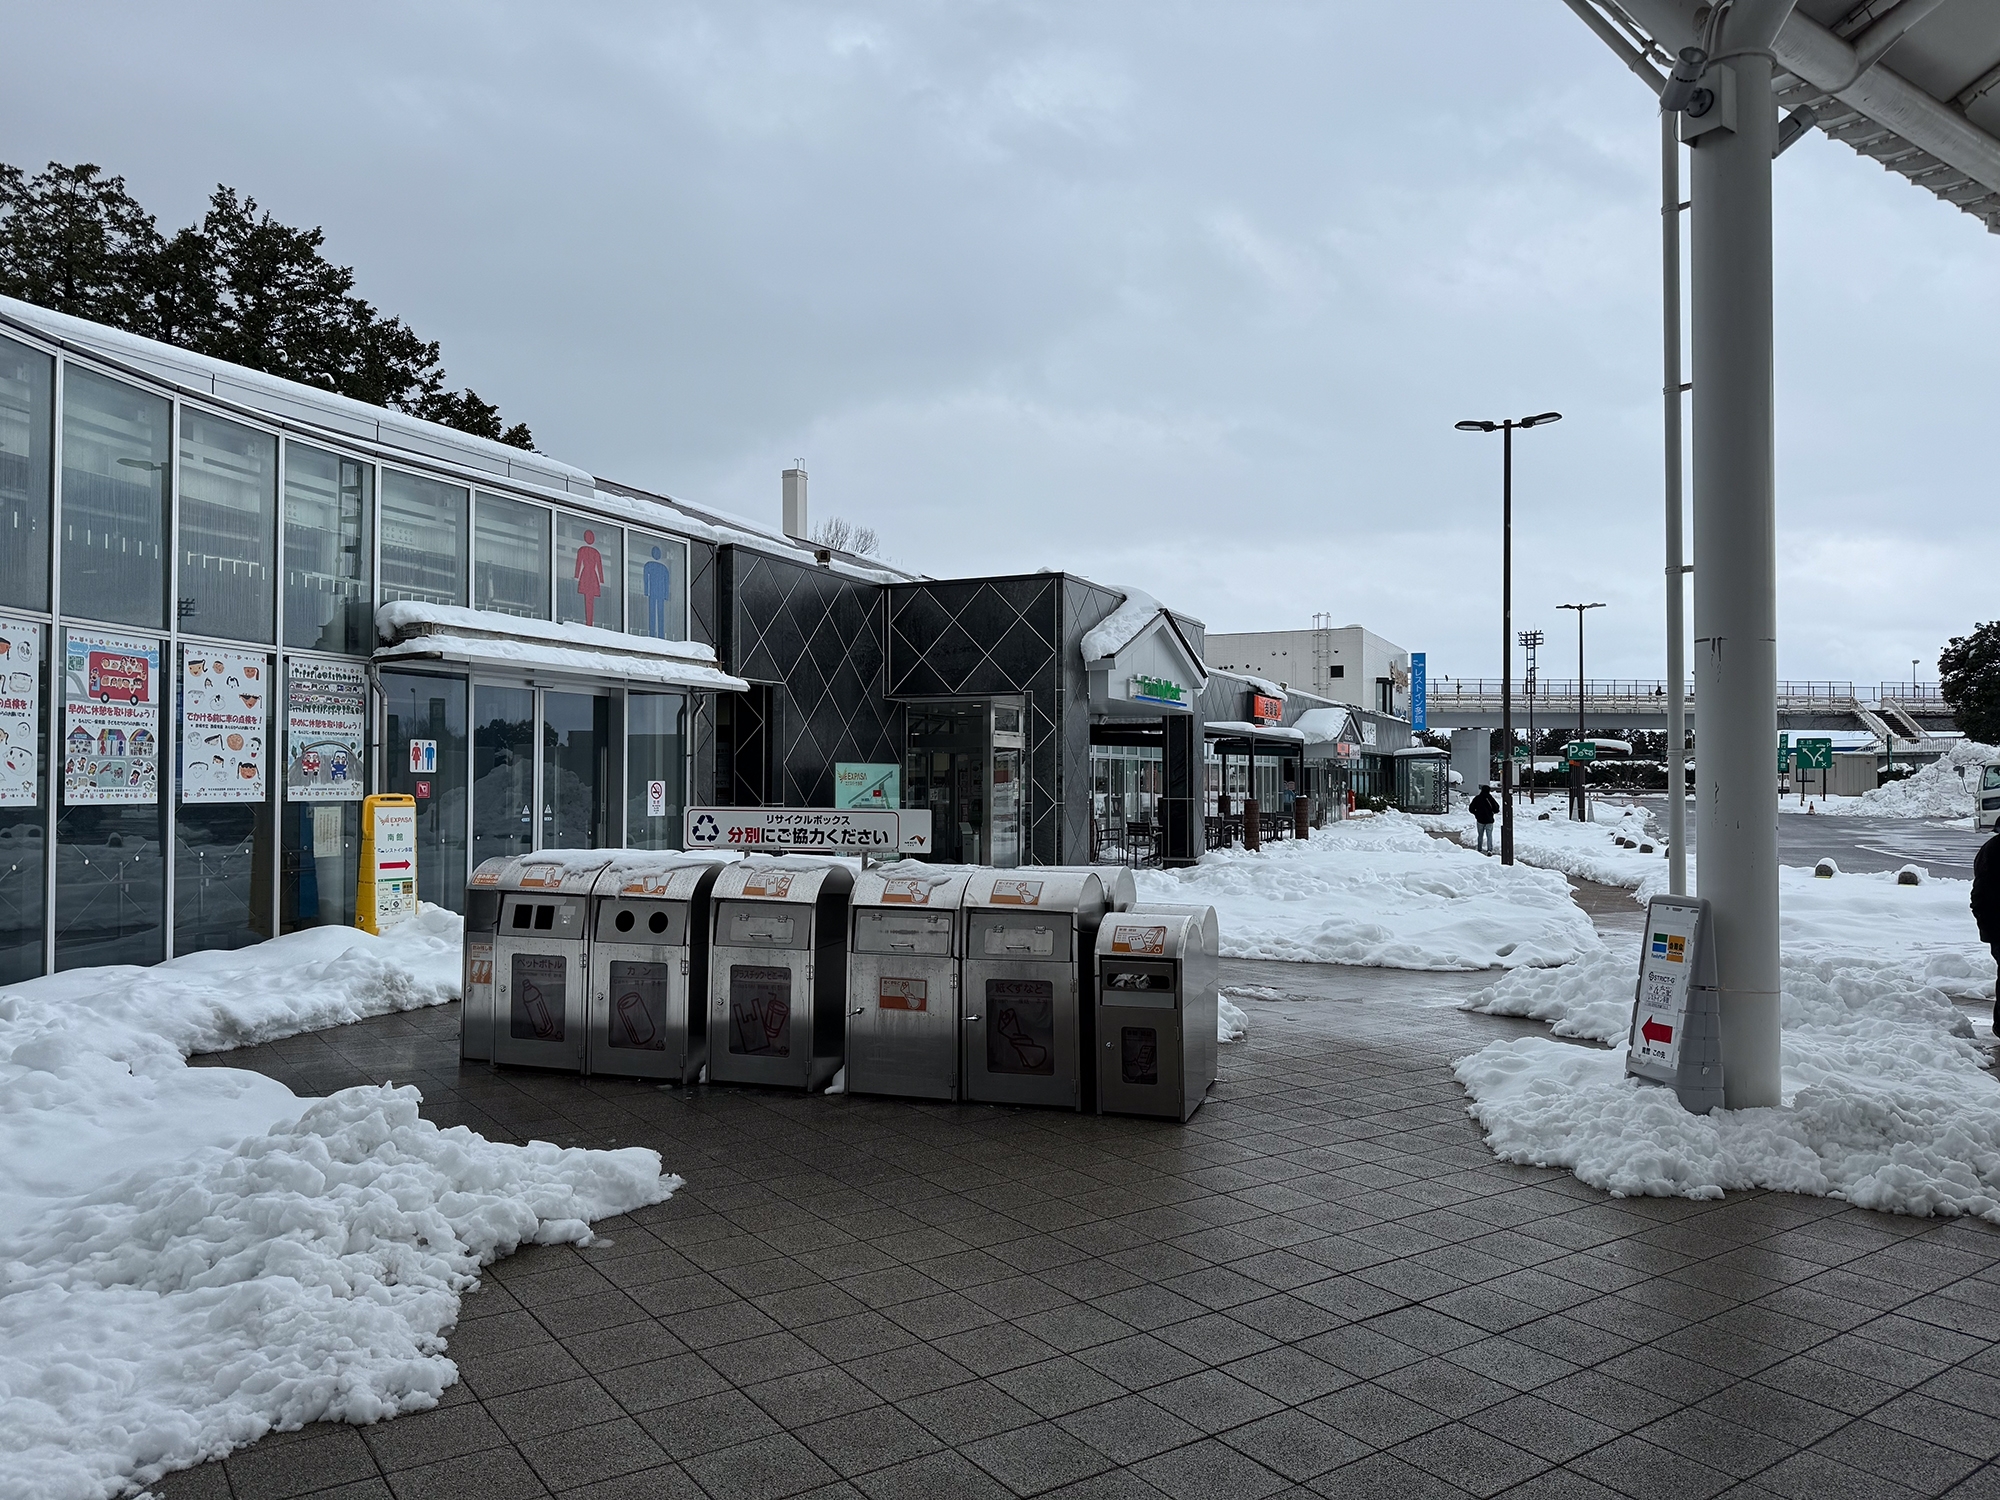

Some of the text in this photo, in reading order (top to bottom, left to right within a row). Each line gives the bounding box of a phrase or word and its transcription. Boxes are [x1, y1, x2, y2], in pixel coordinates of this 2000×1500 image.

[1514, 746, 1520, 756] P
[1569, 745, 1579, 757] P
[766, 814, 851, 825] リサイクルボックス
[728, 827, 889, 845] 分別にご協力ください
[517, 959, 562, 970] ペットボトル
[995, 983, 1043, 995] 紙くずなど
